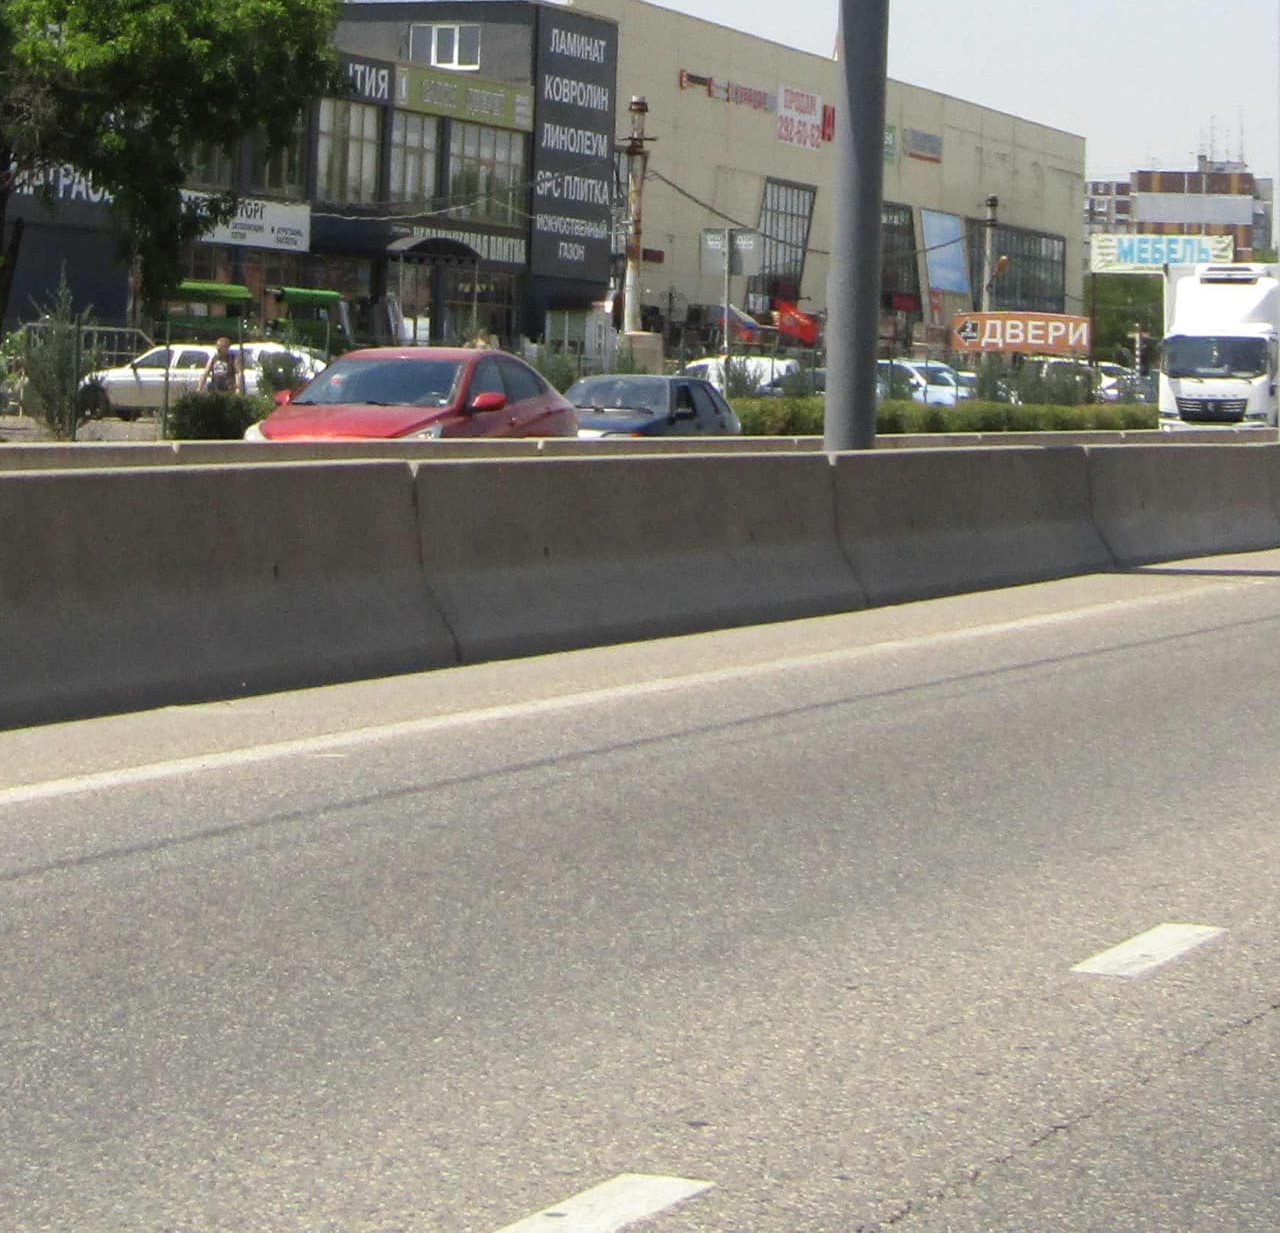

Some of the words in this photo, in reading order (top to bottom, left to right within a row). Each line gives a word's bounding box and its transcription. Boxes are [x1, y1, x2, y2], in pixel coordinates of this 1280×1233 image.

[549, 28, 607, 63] ЛАМИНАТ
[544, 74, 609, 112] КОВРОЛИН
[542, 122, 607, 159] ЛИНОЛЕУМ
[563, 174, 609, 204] ПЛИТКА
[558, 241, 585, 261] ГАЗОН
[1117, 238, 1211, 264] МЕБЕЛЬ
[981, 320, 1089, 347] ДВЕРИ
